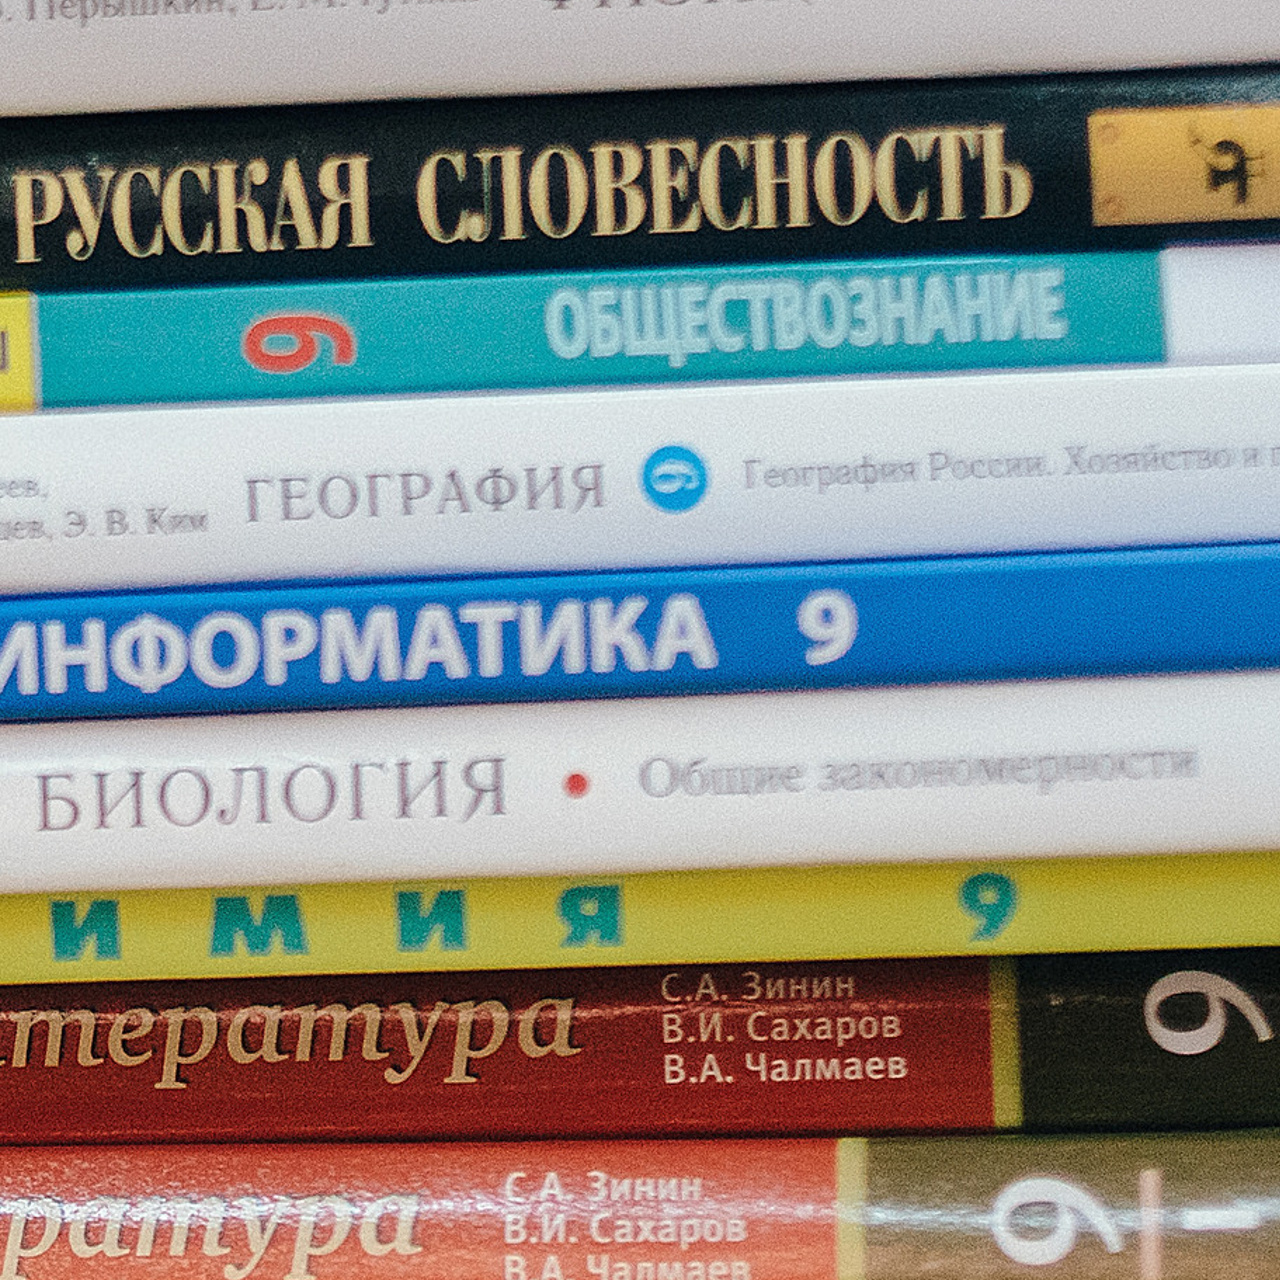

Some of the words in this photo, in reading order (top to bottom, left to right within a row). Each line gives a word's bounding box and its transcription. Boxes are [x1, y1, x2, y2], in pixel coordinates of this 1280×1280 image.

[12, 154, 376, 264] РУССКАЯ
[415, 123, 1035, 244] СЛОВЕСНОСТЬ
[243, 313, 357, 374] 9
[544, 267, 1069, 368] ОБЩЕСТВОЗНАНИЕ
[245, 462, 605, 523] ГЕОГРАФИЯ
[742, 449, 917, 497] География
[928, 451, 1052, 481] России.
[1063, 443, 1231, 475] Хозяйство
[1242, 446, 1259, 469] и
[63, 511, 100, 539] Э.
[107, 509, 138, 538] В.
[146, 506, 210, 537] Ким
[796, 587, 860, 667] 9
[36, 756, 509, 833] БИОЛОГИЯ
[638, 756, 804, 800] Общие
[816, 748, 1199, 796] закономерности
[957, 871, 1019, 942] 9
[661, 973, 729, 1005] С.А.
[741, 971, 856, 1002] Зинин
[1143, 969, 1274, 1055] 9
[662, 1012, 736, 1045] В.И.
[746, 1011, 903, 1051] Сахаров
[663, 1052, 734, 1085] В.А.
[745, 1050, 908, 1084] Чалмаев
[504, 1170, 568, 1203] С.А.
[587, 1170, 703, 1203] Зинин
[503, 1212, 580, 1245] В.И.
[589, 1211, 749, 1250] Сахаров
[990, 1175, 1123, 1266] 9
